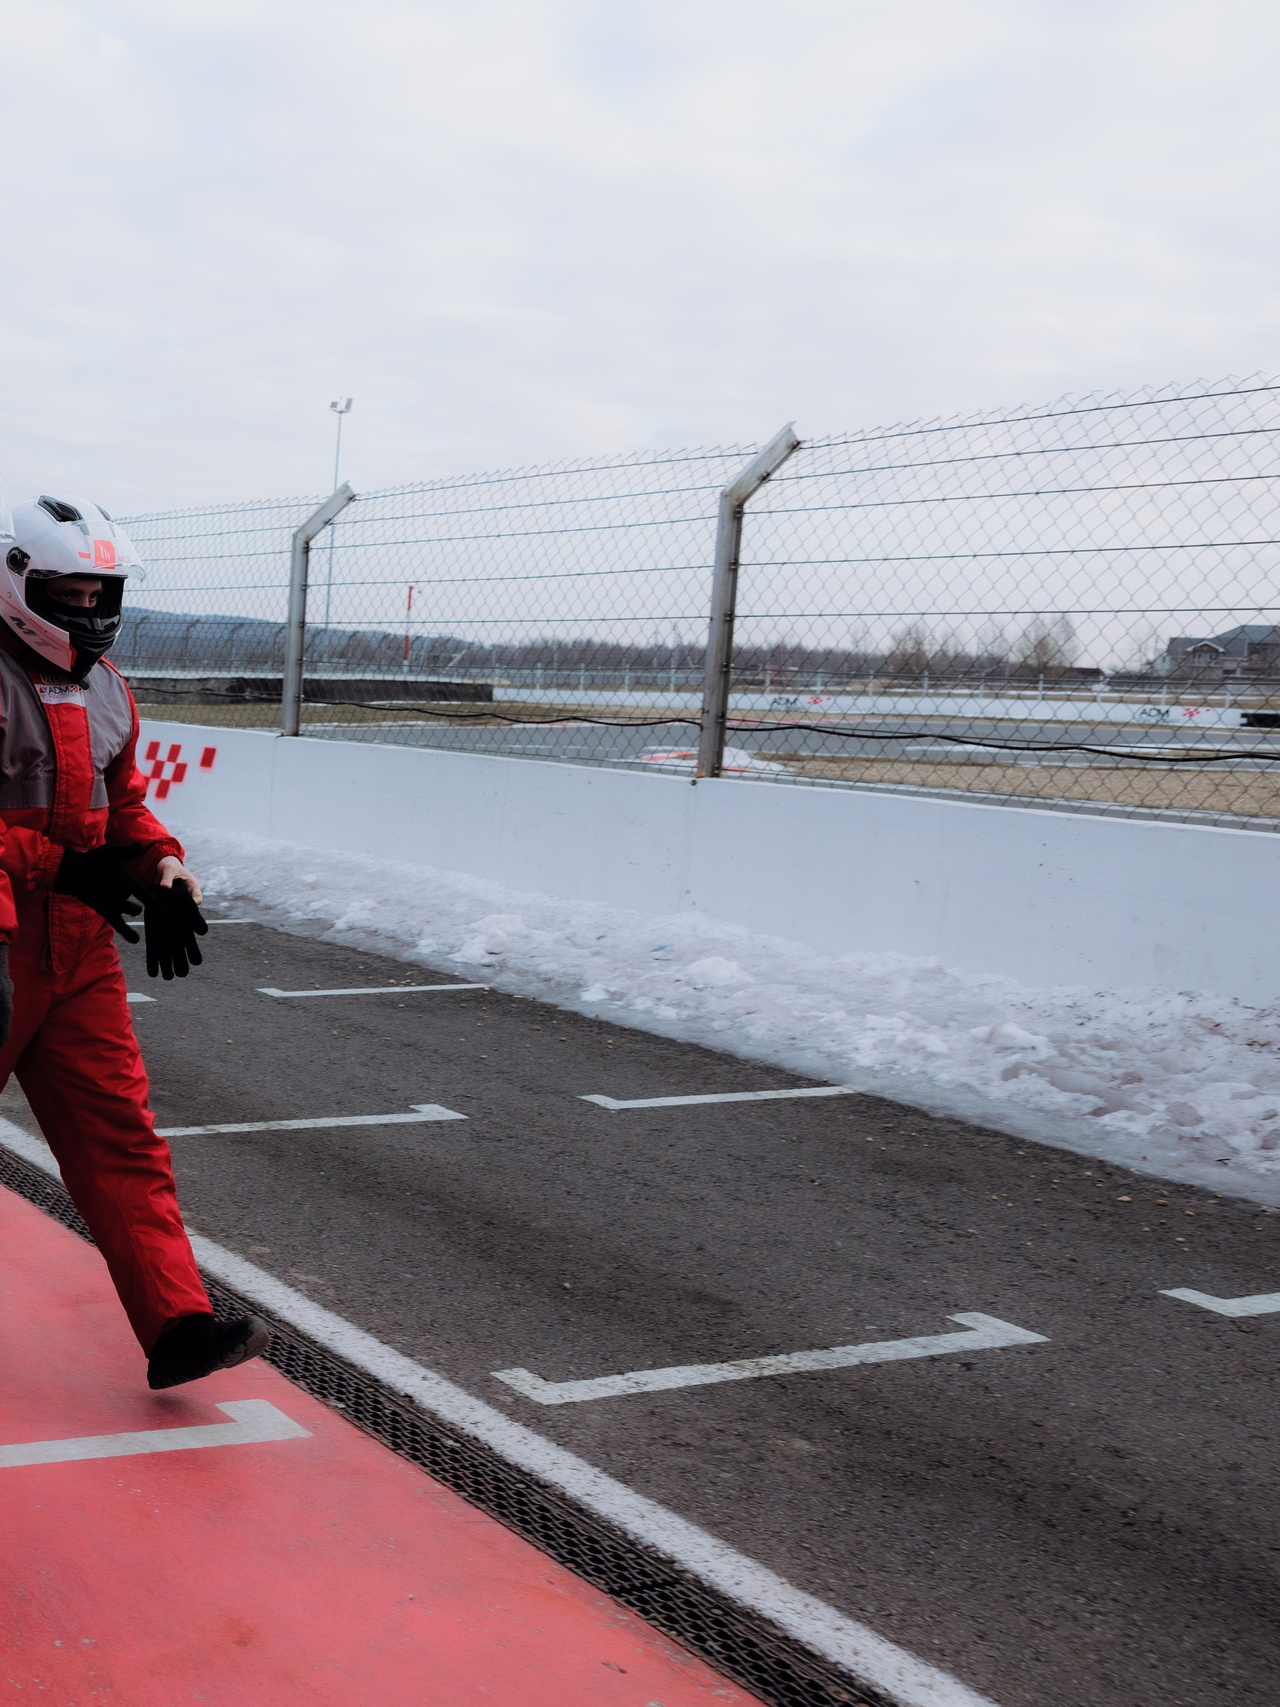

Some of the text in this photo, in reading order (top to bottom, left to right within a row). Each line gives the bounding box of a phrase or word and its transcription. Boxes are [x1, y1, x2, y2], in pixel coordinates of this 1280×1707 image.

[9, 616, 61, 651] MT
[49, 686, 70, 694] ADM
[1139, 707, 1170, 717] ADM
